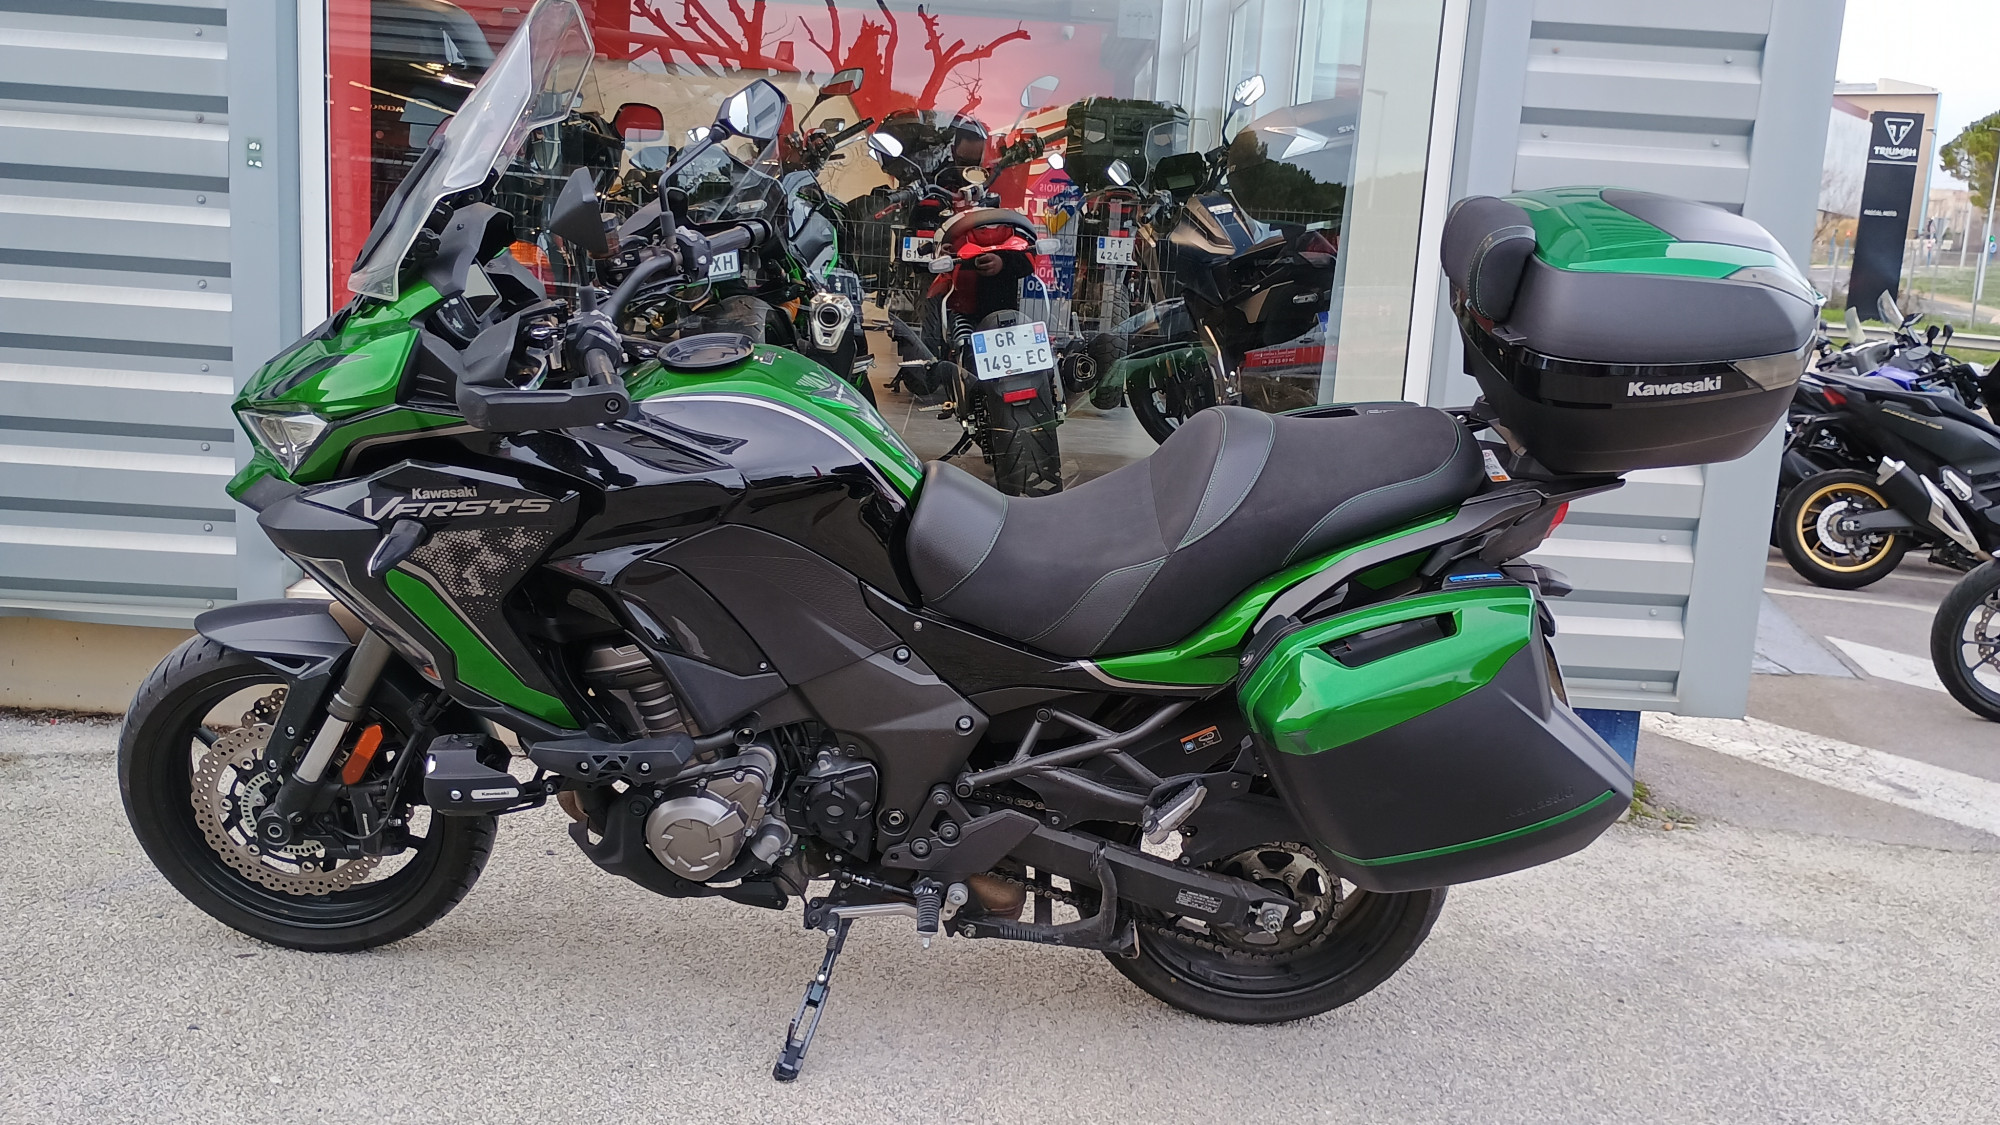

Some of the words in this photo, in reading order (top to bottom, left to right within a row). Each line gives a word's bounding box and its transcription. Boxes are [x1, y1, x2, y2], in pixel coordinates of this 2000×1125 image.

[1873, 145, 1917, 157] TRIUMPH
[1035, 333, 1046, 343] 34
[1626, 375, 1722, 397] Kawasaki
[411, 486, 478, 499] Kawasaki
[363, 497, 553, 521] VERSYS
